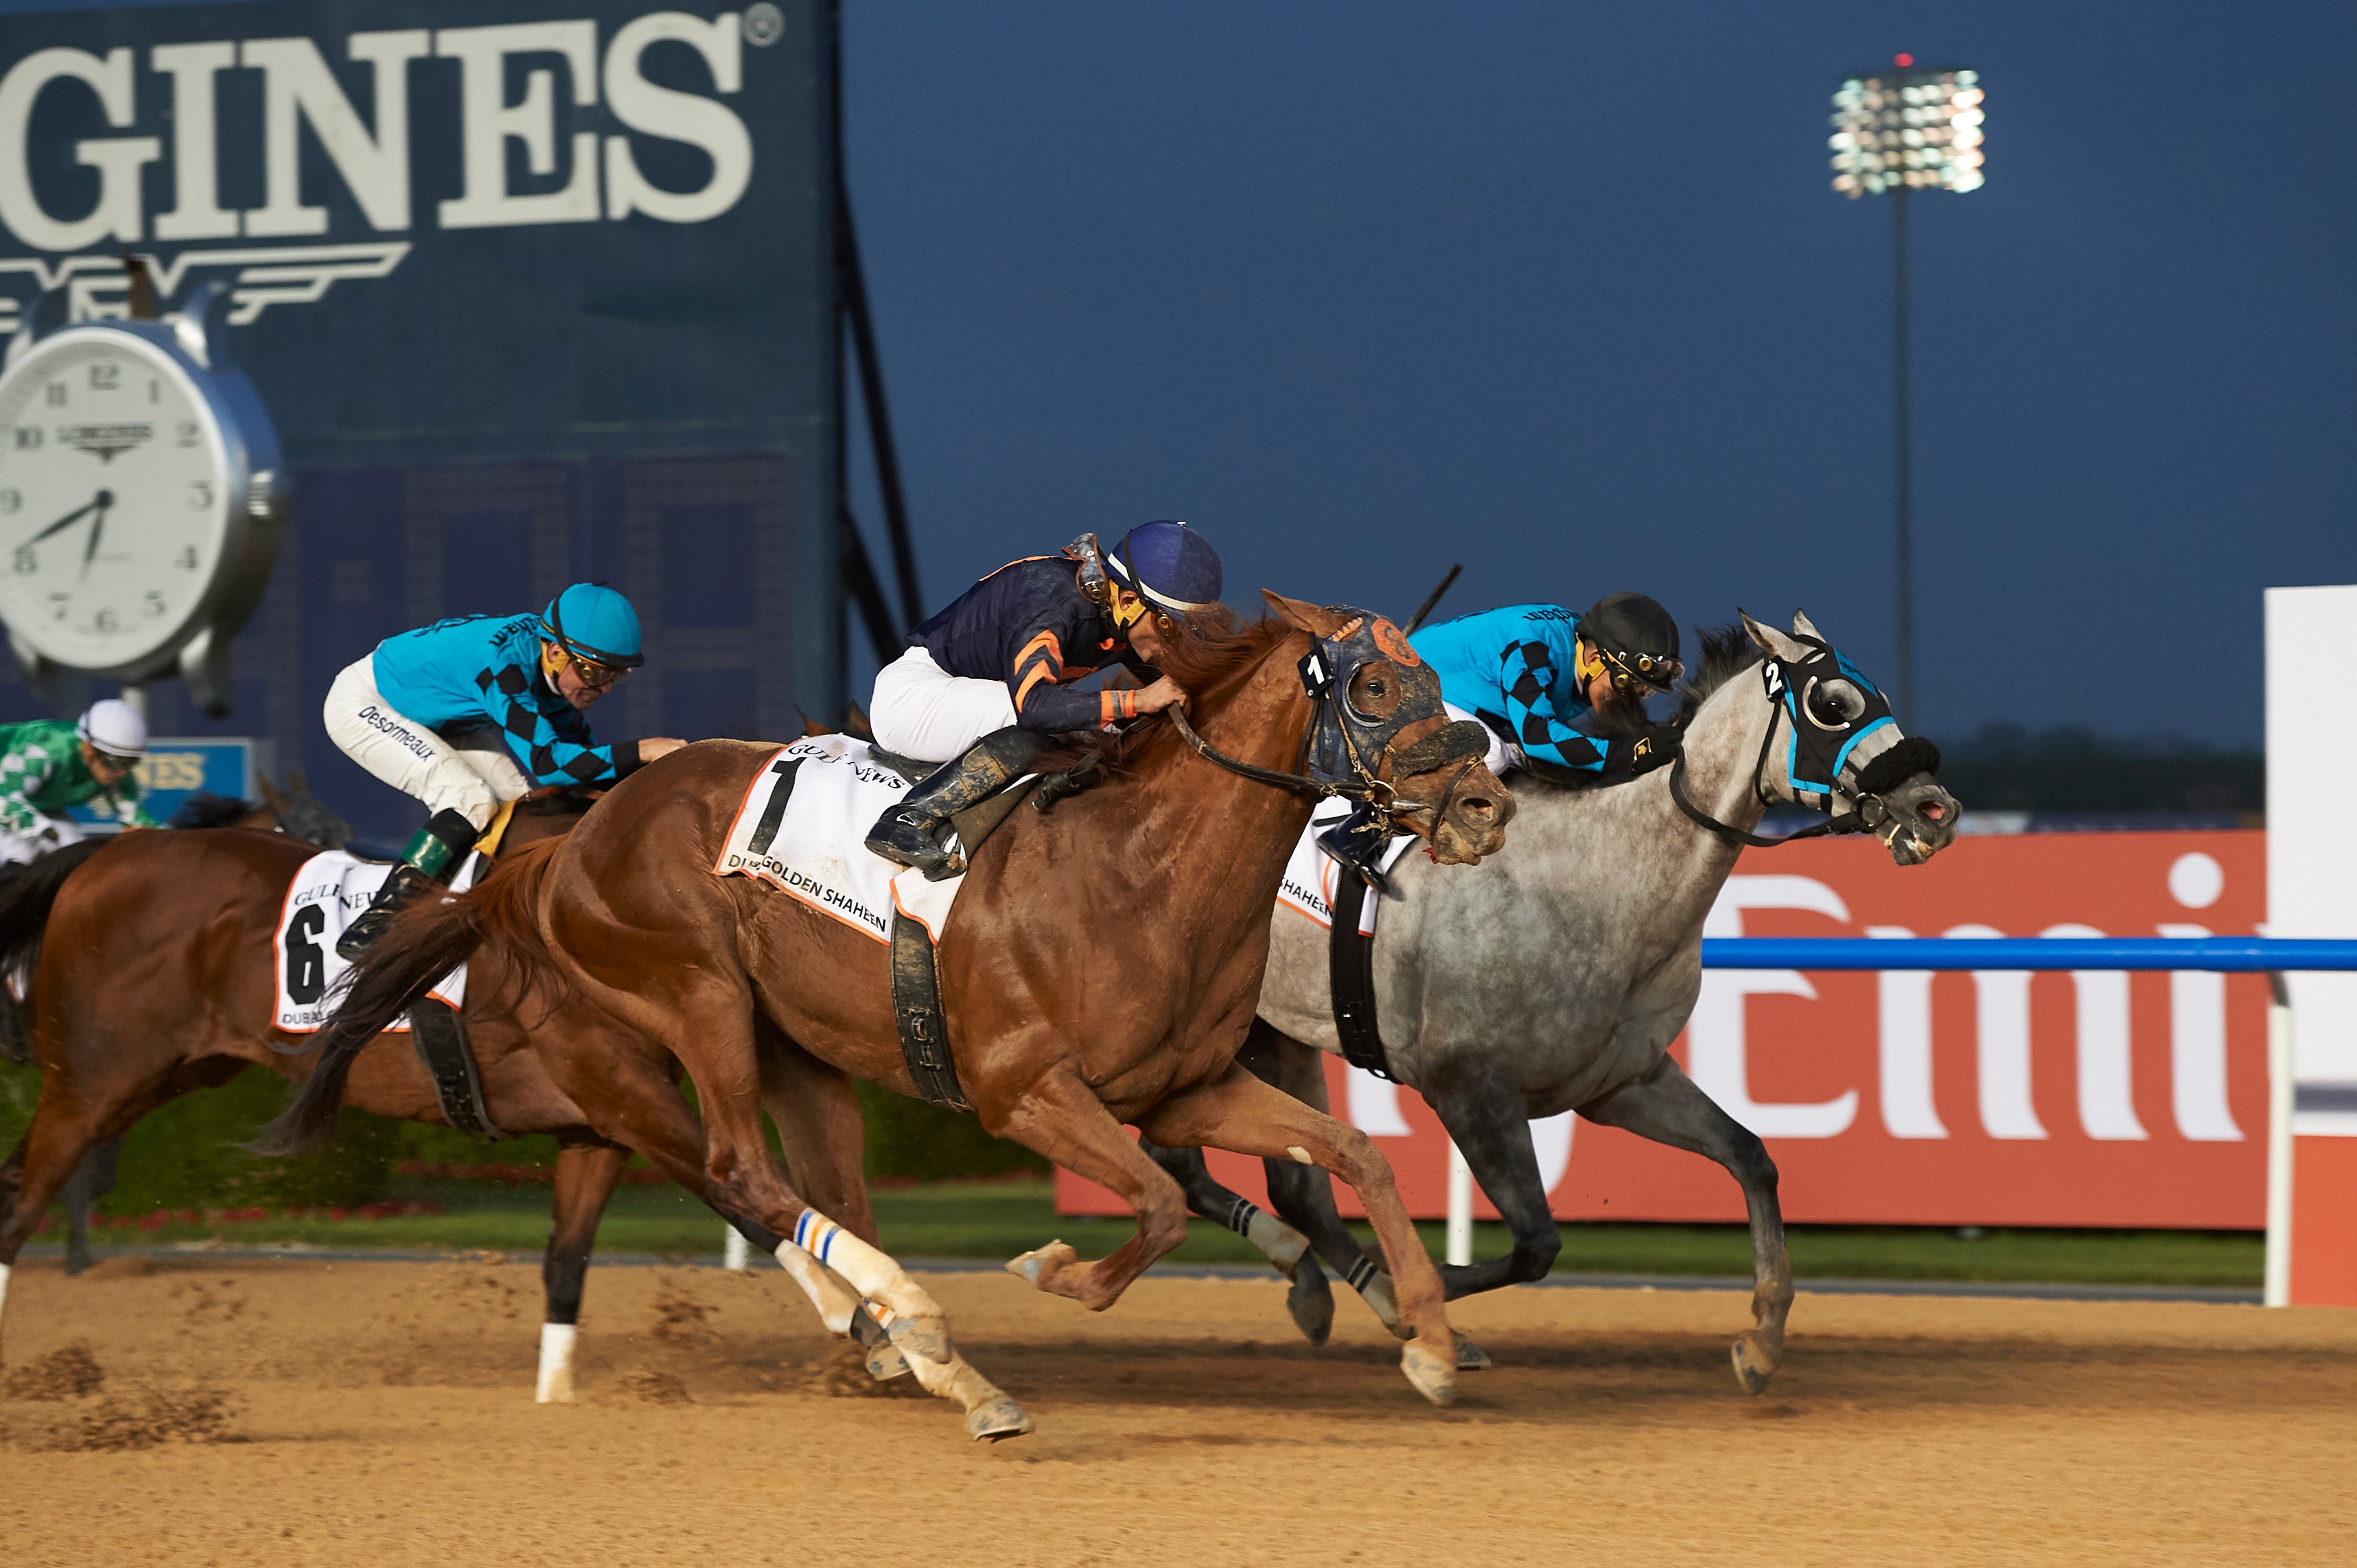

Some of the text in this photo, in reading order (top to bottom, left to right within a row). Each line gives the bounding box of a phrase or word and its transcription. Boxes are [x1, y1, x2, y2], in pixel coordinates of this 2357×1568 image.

[0, 10, 753, 251] GINES
[1307, 655, 1325, 685] 1
[1765, 662, 1783, 694] 2
[358, 705, 437, 762] Desormeaux
[747, 756, 807, 856] 1
[762, 855, 823, 897] GOLDEN
[823, 889, 887, 933] SHAHEEN
[286, 903, 325, 1005] 6
